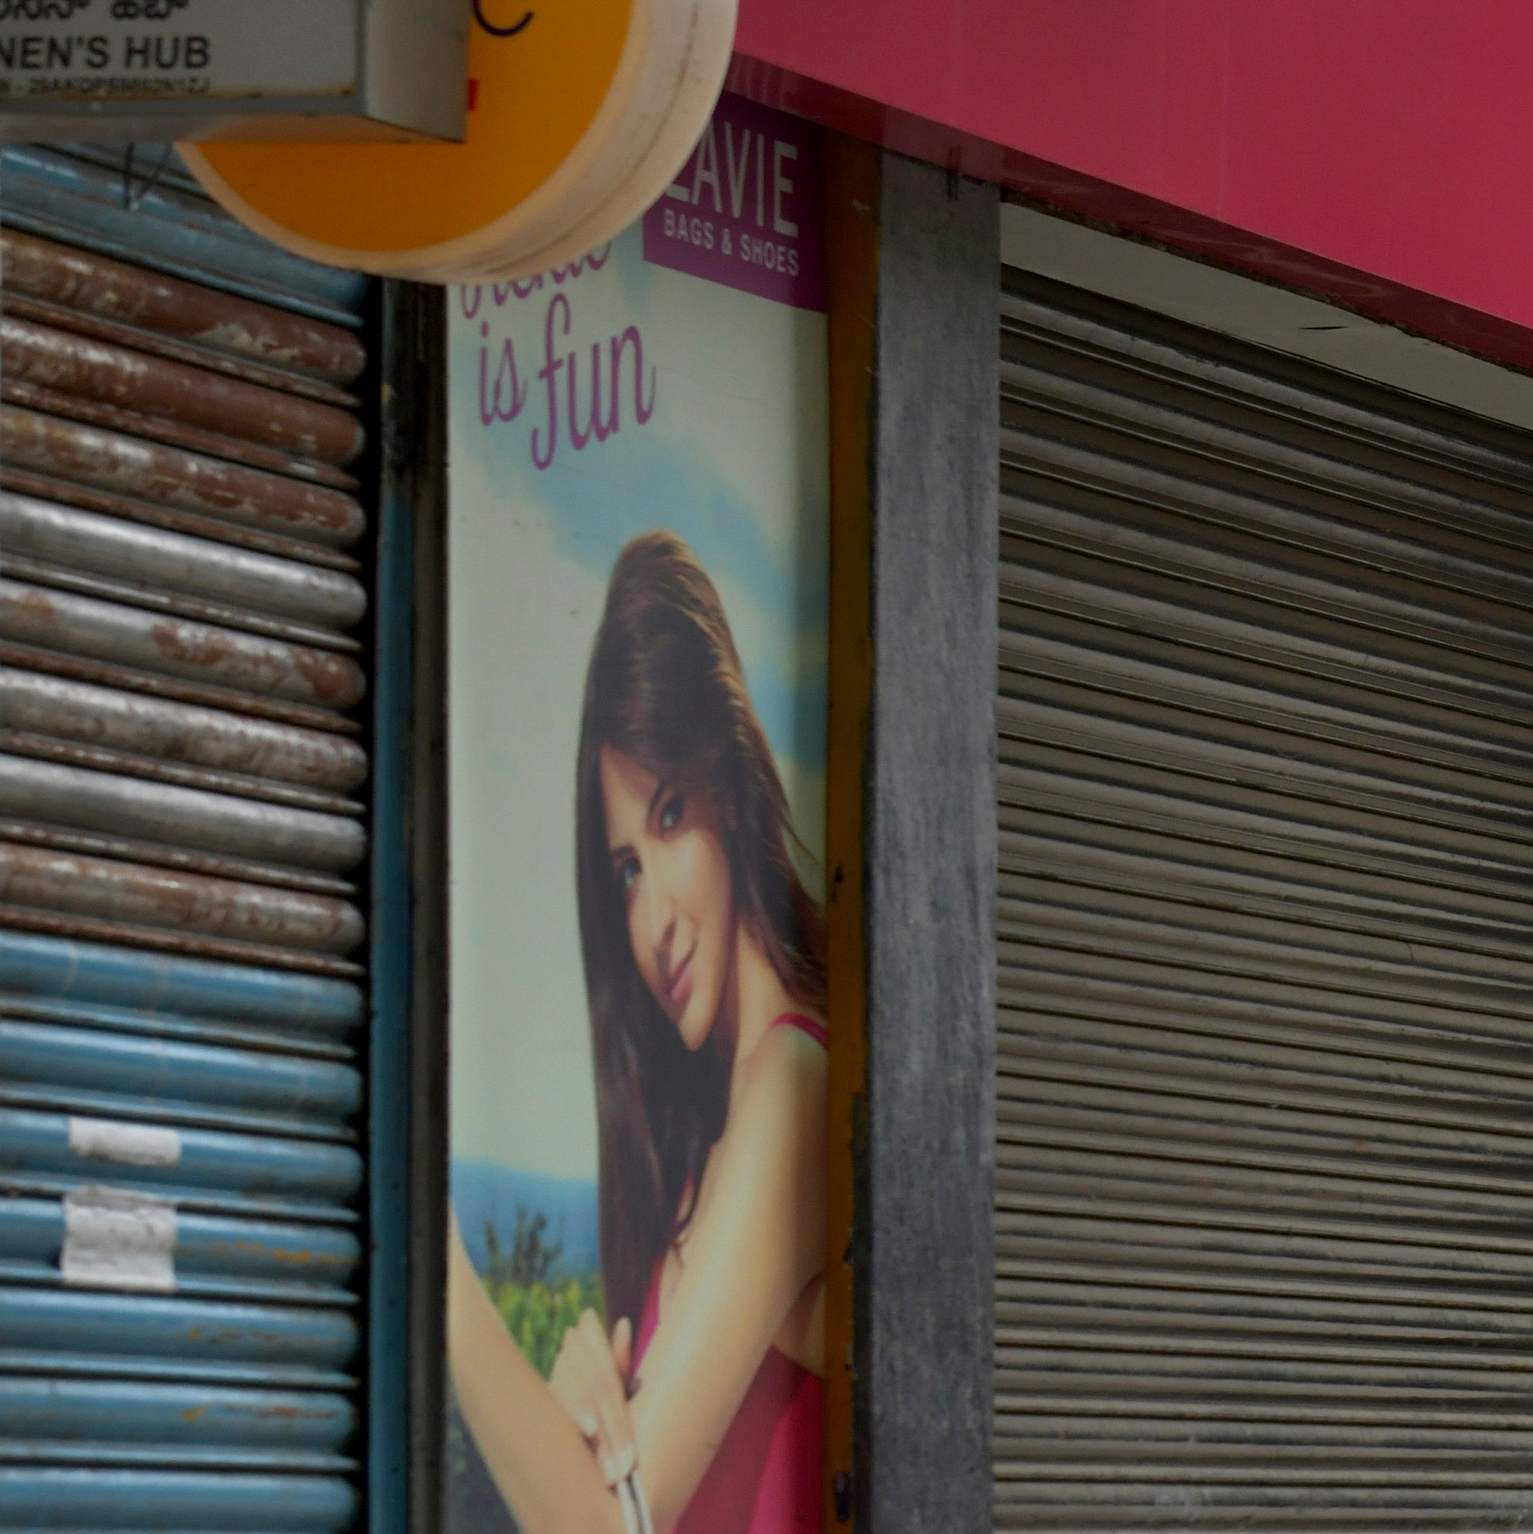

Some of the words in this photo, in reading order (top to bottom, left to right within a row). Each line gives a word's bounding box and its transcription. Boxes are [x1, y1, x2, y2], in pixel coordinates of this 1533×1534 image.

[124, 35, 209, 70] HUB
[664, 208, 714, 252] BAGS
[720, 228, 733, 257] &
[740, 233, 800, 278] SHOES
[479, 320, 528, 428] is
[530, 292, 657, 472] fun
